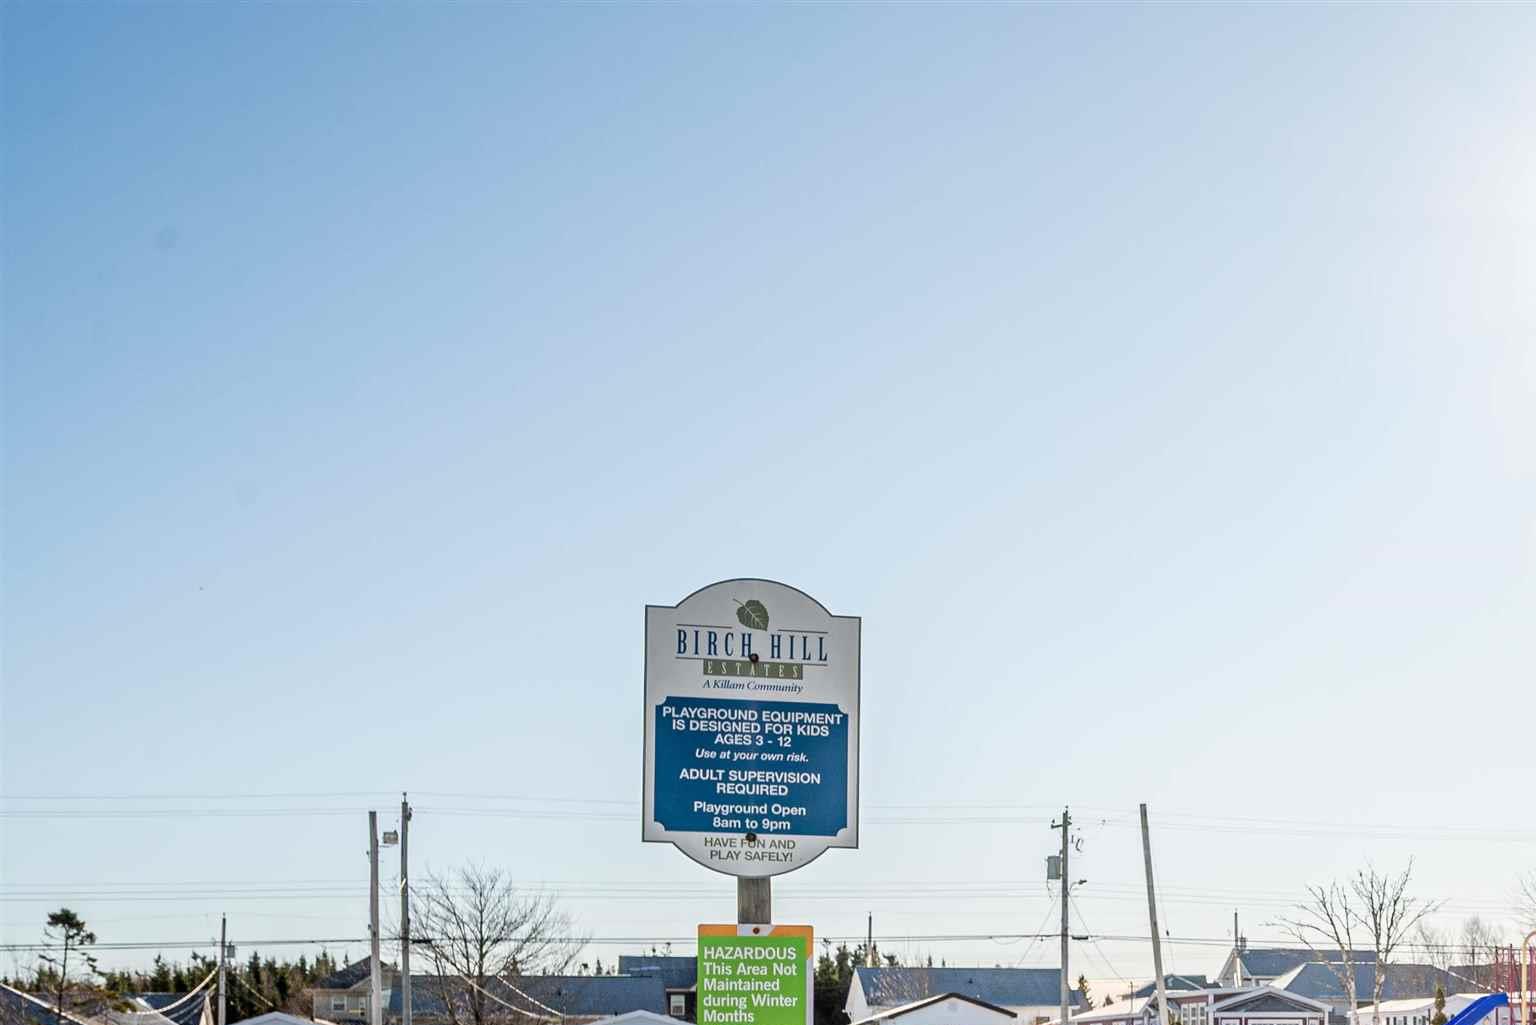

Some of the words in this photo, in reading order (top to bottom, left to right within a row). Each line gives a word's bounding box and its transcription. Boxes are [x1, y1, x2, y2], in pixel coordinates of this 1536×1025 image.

[676, 629, 752, 658] BIRCH
[771, 632, 829, 661] HILL
[706, 662, 800, 678] ESTATES
[702, 680, 712, 689] A
[713, 680, 746, 690] Killam
[747, 682, 804, 694] Community
[663, 706, 758, 721] PLAYGROUND
[762, 712, 843, 725] EQUIPMENT
[672, 719, 685, 730] IS
[690, 720, 760, 734] DESIGNED
[764, 723, 793, 734] FOR
[797, 724, 829, 736] KIDS
[714, 734, 752, 745] AGES
[755, 735, 764, 746] 3
[778, 736, 791, 747] 12
[696, 748, 716, 759] Use
[720, 750, 730, 759] at
[733, 752, 758, 762] your
[761, 752, 784, 762] own
[787, 752, 808, 762] risk.
[680, 769, 724, 782] ADULT
[729, 770, 821, 784] SUPERVISION
[716, 782, 788, 796] REQUIRED
[694, 801, 768, 816] Playground
[772, 804, 806, 818] Open
[713, 817, 741, 828] 8am
[744, 818, 758, 830] to
[762, 819, 790, 833] 9pm
[704, 837, 736, 848] HAVE
[740, 838, 766, 849] FUN
[769, 838, 796, 850] AND
[710, 850, 742, 860] PLAY
[744, 851, 793, 862] SAFELY!
[703, 946, 796, 960] HAZARDOUS
[704, 963, 732, 976] This
[736, 963, 768, 976] Area
[773, 963, 797, 976] Not
[703, 979, 780, 991] Maintained
[703, 994, 747, 1010] during
[752, 994, 798, 1006] Winter
[703, 1010, 755, 1022] Months
